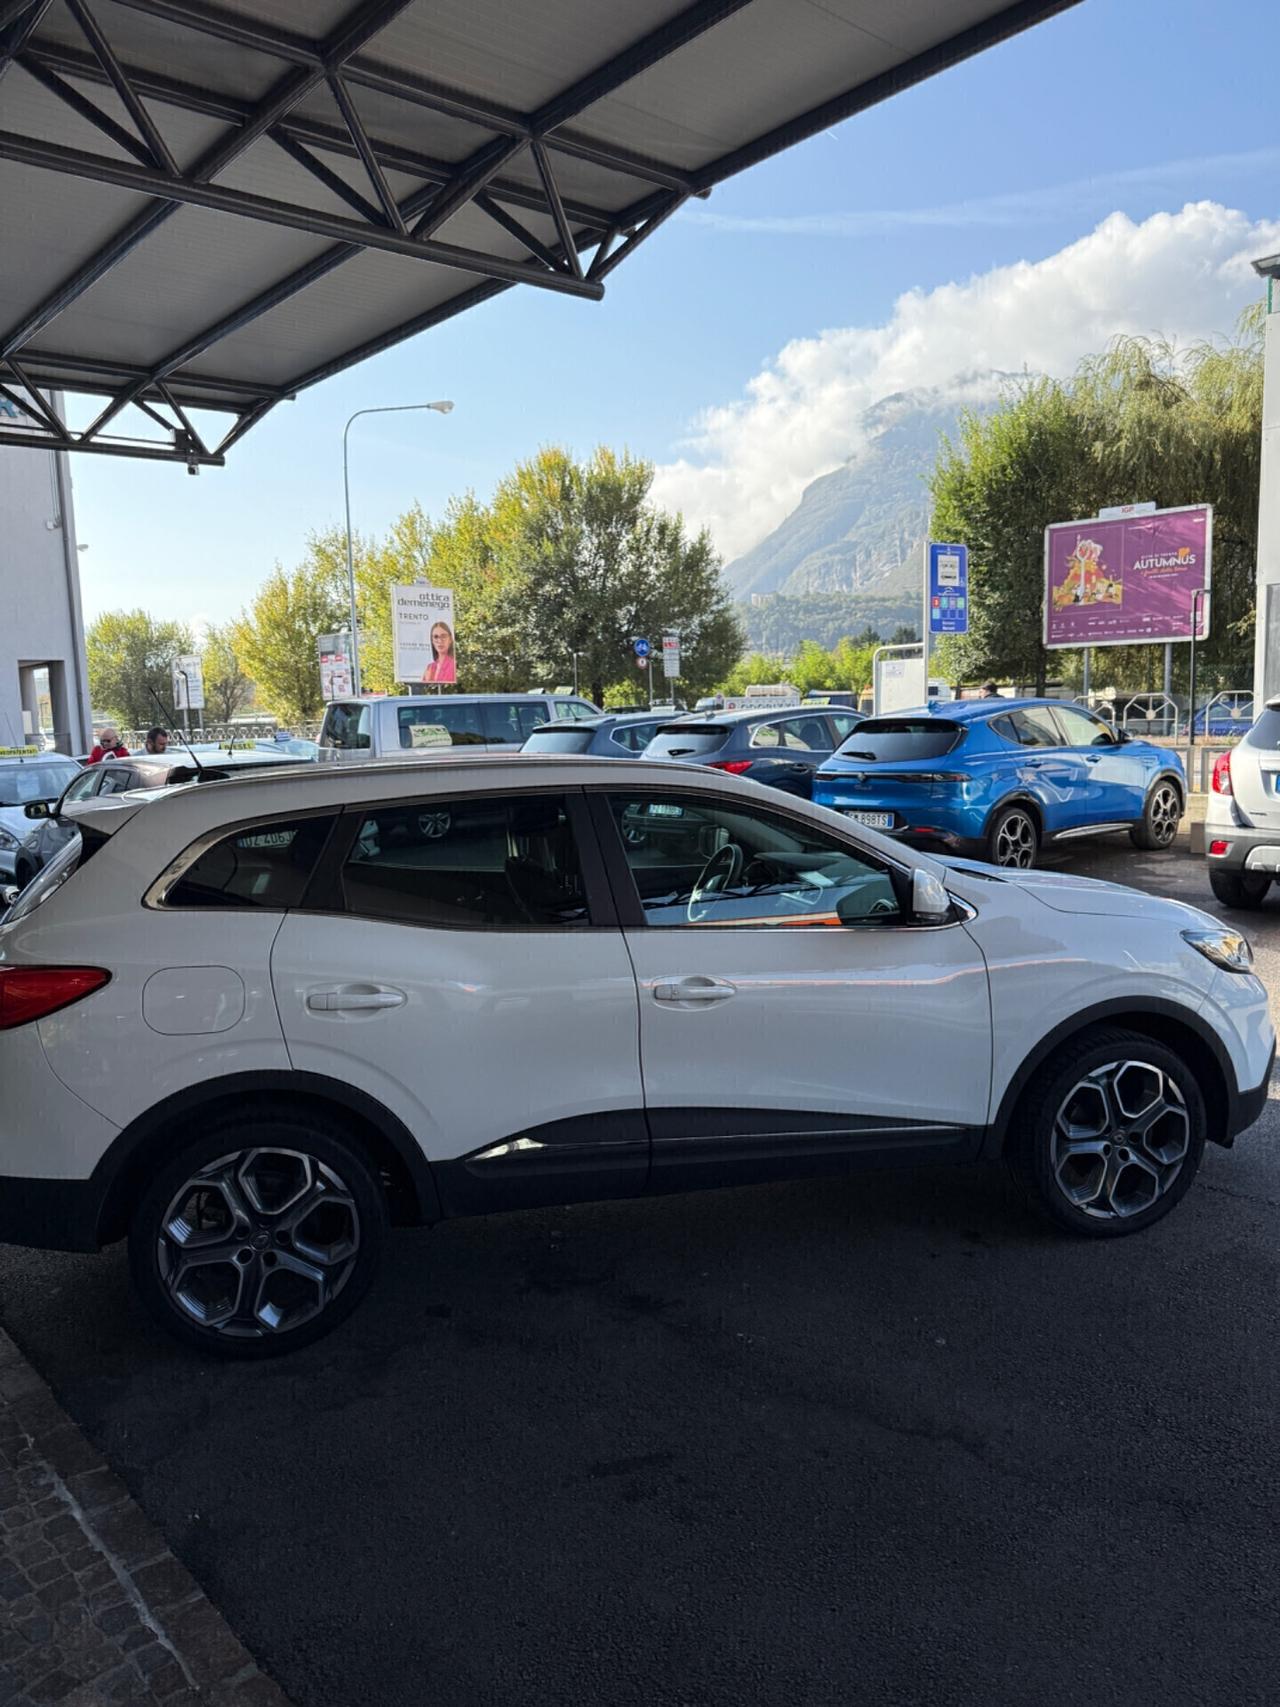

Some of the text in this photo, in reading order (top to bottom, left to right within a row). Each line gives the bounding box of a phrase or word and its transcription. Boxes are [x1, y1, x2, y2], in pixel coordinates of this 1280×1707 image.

[1133, 554, 1197, 570] AUTUMNUS
[419, 592, 450, 602] ottica
[397, 598, 450, 611] demenego
[399, 612, 429, 621] TRENTO
